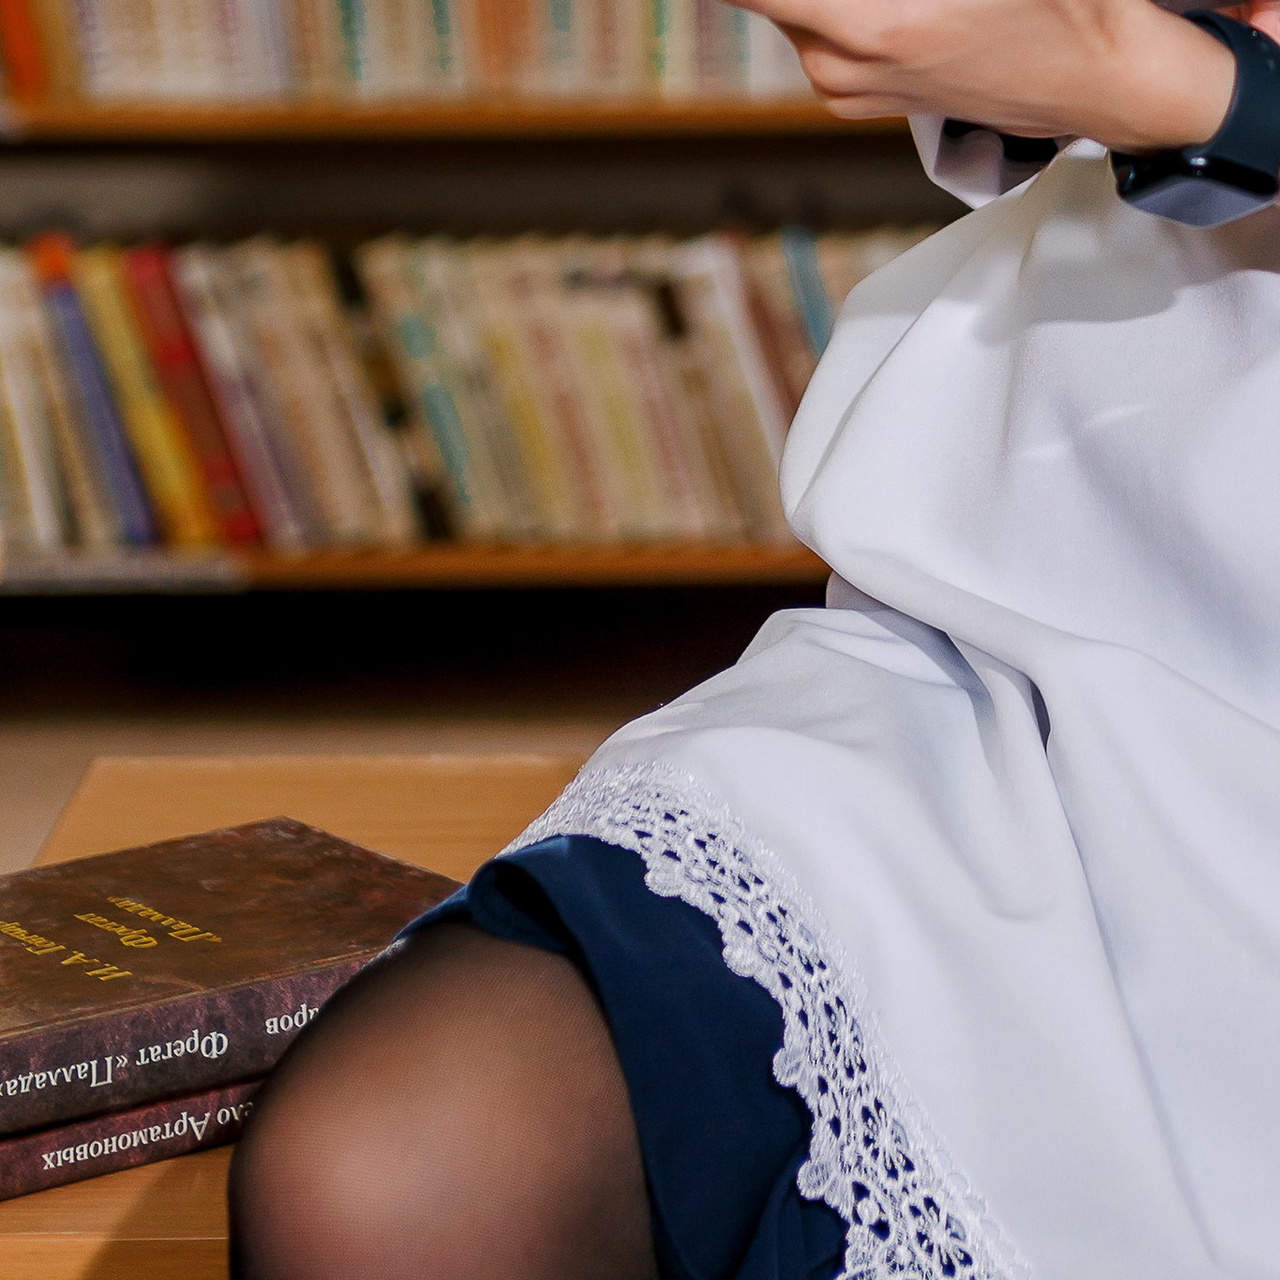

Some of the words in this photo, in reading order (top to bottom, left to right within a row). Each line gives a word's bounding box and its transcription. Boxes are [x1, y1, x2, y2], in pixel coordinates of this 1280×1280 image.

[73, 912, 159, 949] Фрегат
[136, 1028, 230, 1067] Фрегат
[41, 1110, 213, 1171] Артамоновых
